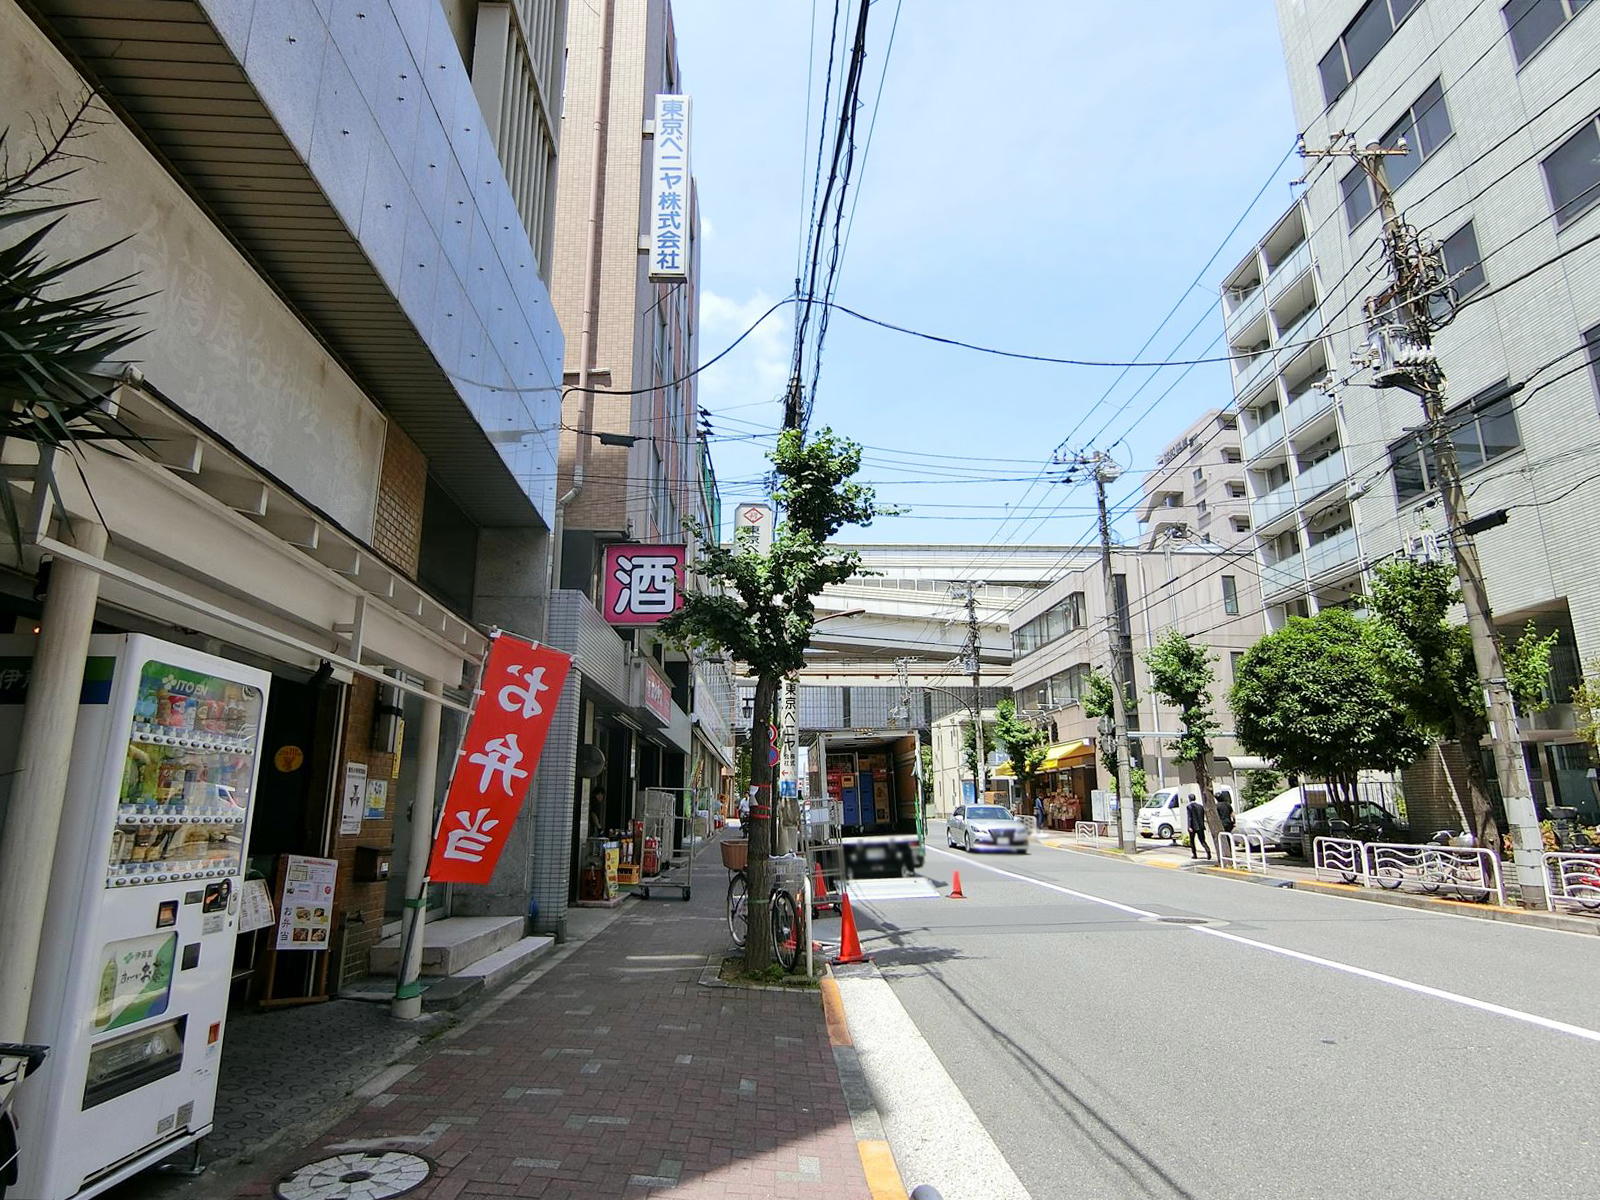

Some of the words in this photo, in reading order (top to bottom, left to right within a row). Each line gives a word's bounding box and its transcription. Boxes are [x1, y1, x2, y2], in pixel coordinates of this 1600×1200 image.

[656, 99, 685, 270] 東京ベニヤ株式会社
[613, 554, 678, 615] 酒
[176, 679, 194, 693] ITO
[194, 685, 208, 696] EN
[785, 683, 796, 751] 東京ベニヤ
[443, 664, 549, 863] お弁当
